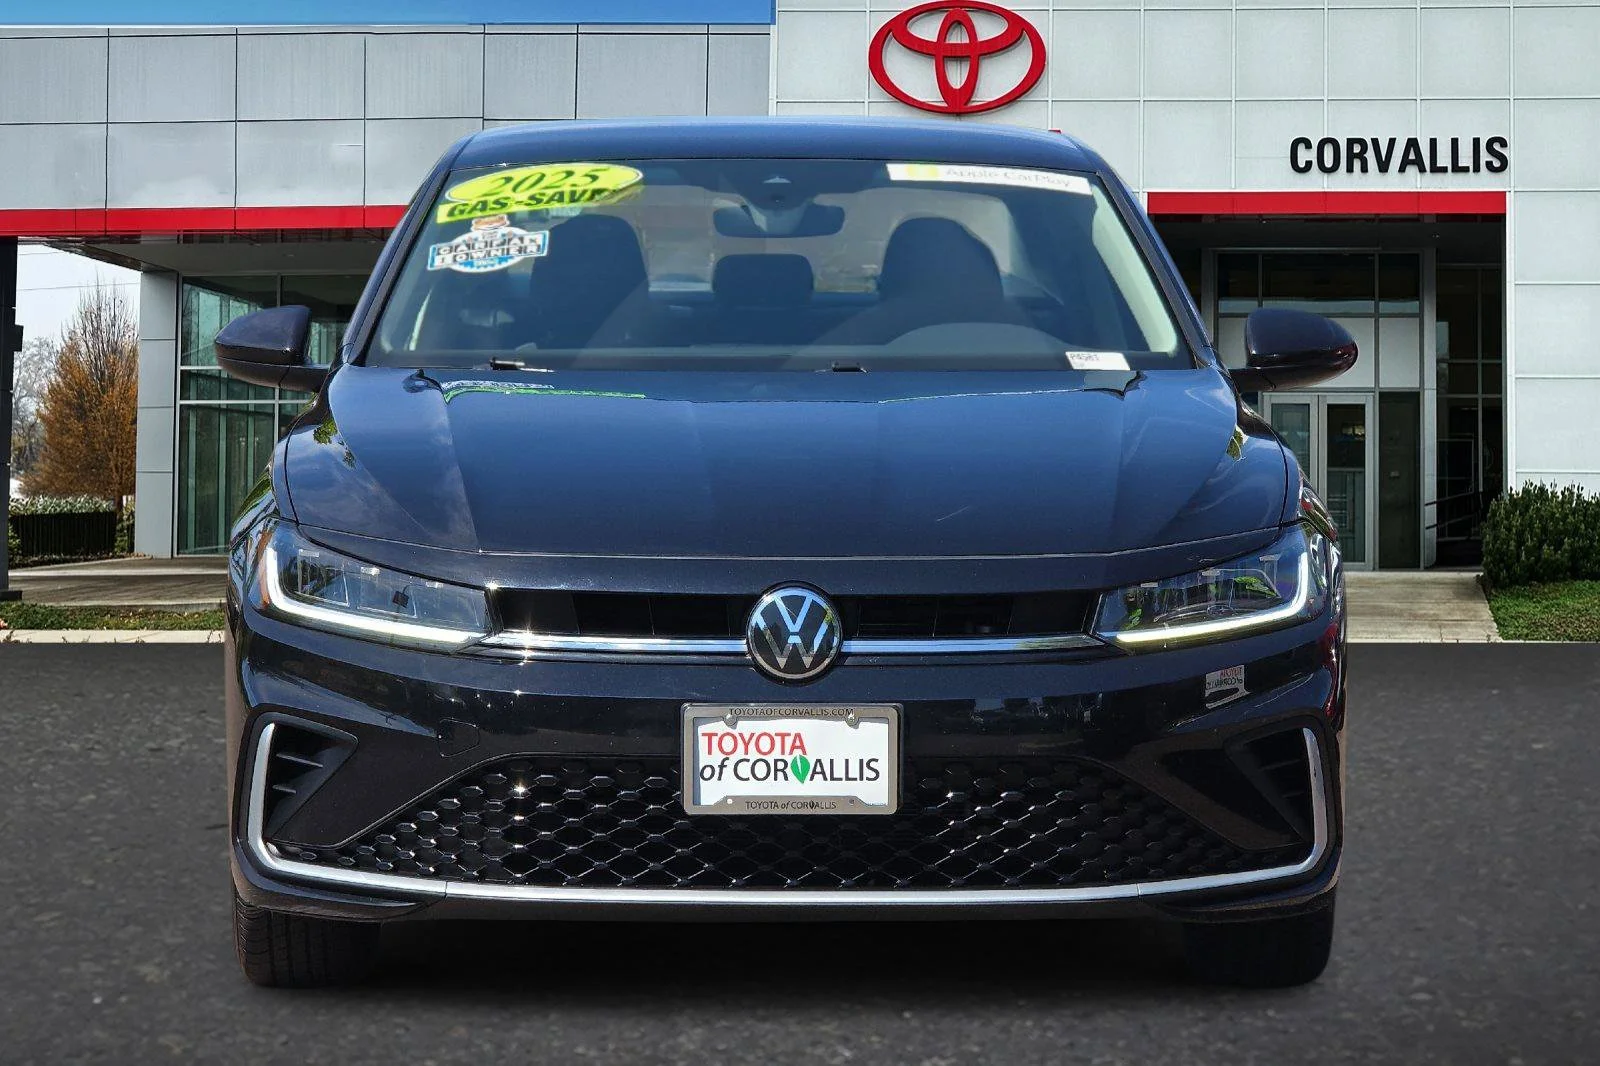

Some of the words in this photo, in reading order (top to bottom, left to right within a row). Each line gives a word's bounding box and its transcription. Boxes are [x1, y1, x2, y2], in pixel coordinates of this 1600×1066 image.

[1290, 136, 1508, 173] CORVALLIS
[482, 168, 609, 198] 2025
[729, 707, 855, 716] TOYOTAOFCORVALLIS.COM
[701, 731, 808, 756] TOYOTA
[700, 757, 729, 782] of
[745, 801, 779, 810] TOYOTA
[780, 801, 790, 810] of
